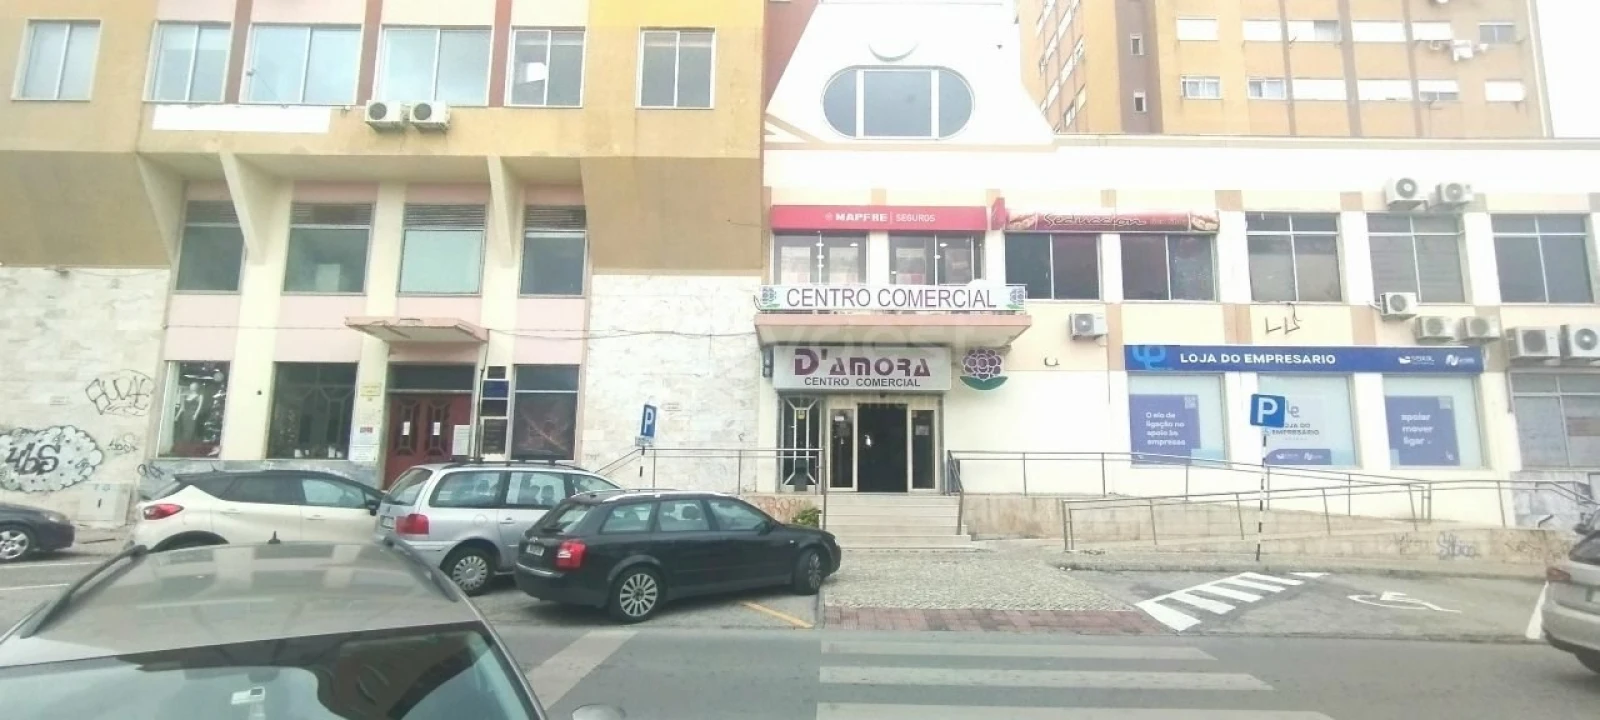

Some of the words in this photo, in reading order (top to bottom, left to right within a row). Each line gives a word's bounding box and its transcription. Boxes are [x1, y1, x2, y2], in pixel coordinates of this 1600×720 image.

[835, 213, 888, 222] MAPFRE
[895, 213, 936, 222] SEGUROS
[786, 288, 871, 307] CENTRO
[877, 287, 997, 308] COMERCIAL
[1180, 353, 1217, 364] LOJA
[1221, 354, 1241, 364] DO
[804, 377, 850, 387] CENTRO
[855, 377, 921, 388] COMERCIAL
[1257, 397, 1278, 424] P
[643, 407, 655, 434] P
